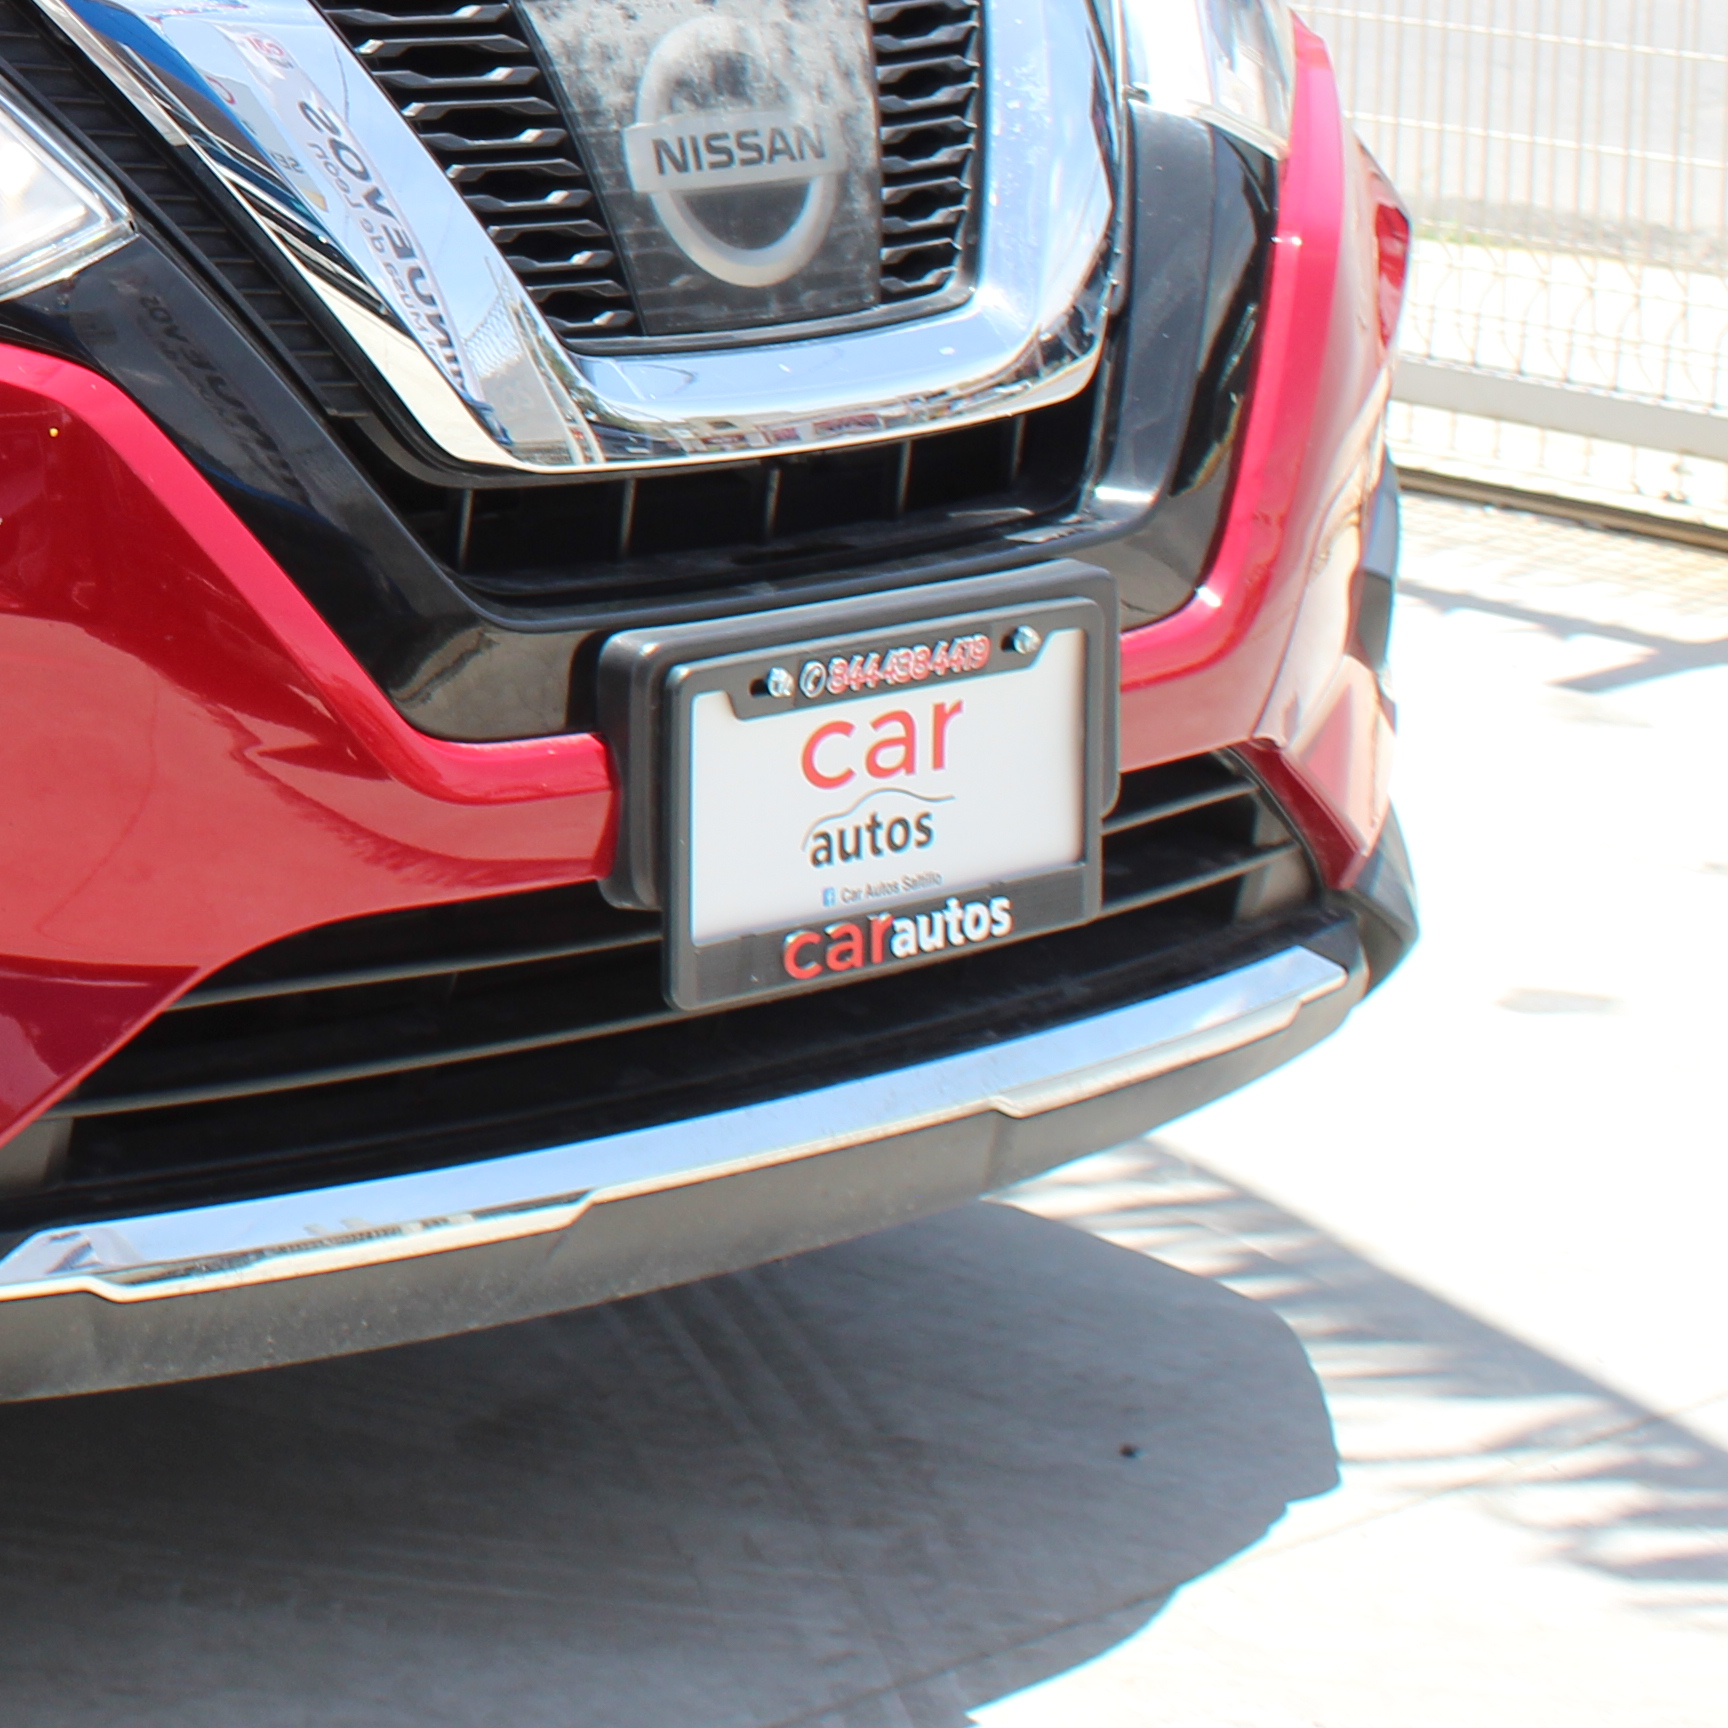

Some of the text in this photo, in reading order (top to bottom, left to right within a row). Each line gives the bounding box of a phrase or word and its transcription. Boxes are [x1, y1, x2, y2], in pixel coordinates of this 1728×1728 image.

[652, 123, 827, 176] NISSAN
[801, 698, 964, 790] car
[809, 809, 934, 869] autos
[783, 894, 1013, 980] carautos
